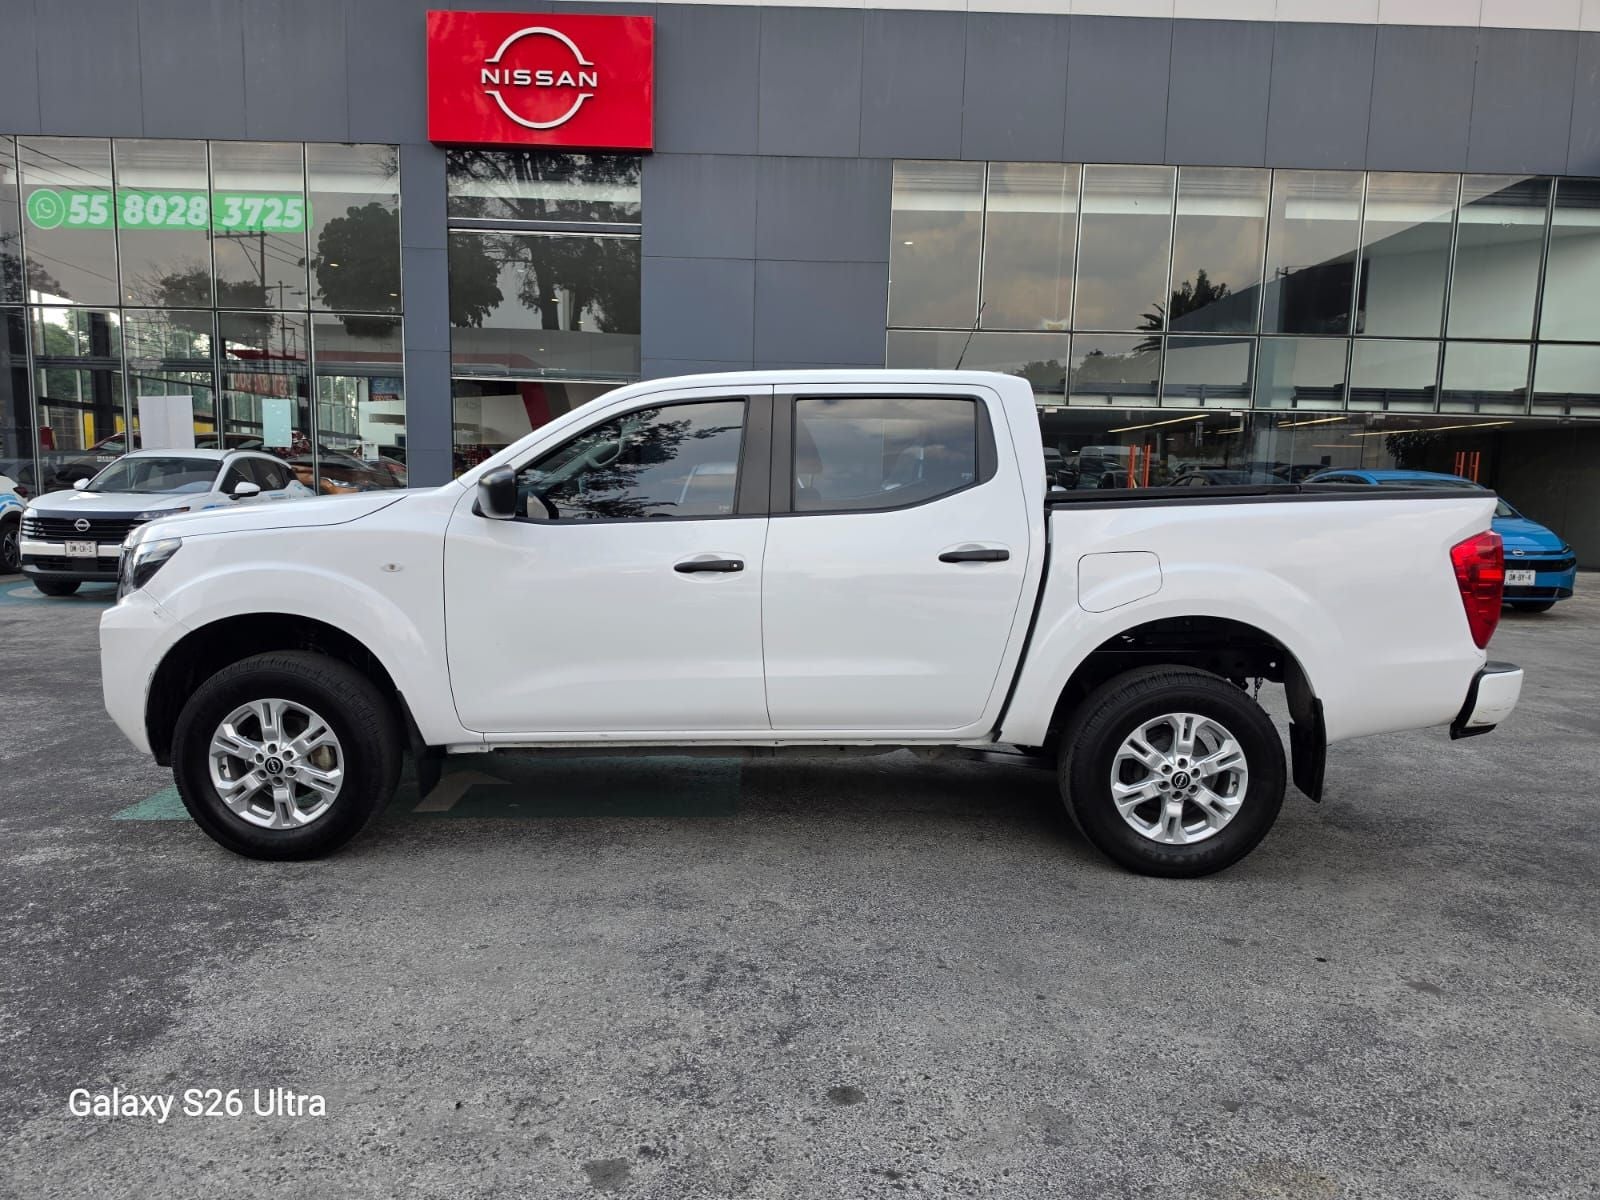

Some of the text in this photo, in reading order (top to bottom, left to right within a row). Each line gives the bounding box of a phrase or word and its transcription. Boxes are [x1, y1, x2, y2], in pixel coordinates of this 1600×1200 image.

[480, 68, 598, 88] NISSAN
[67, 194, 304, 229] 55 8028 3725
